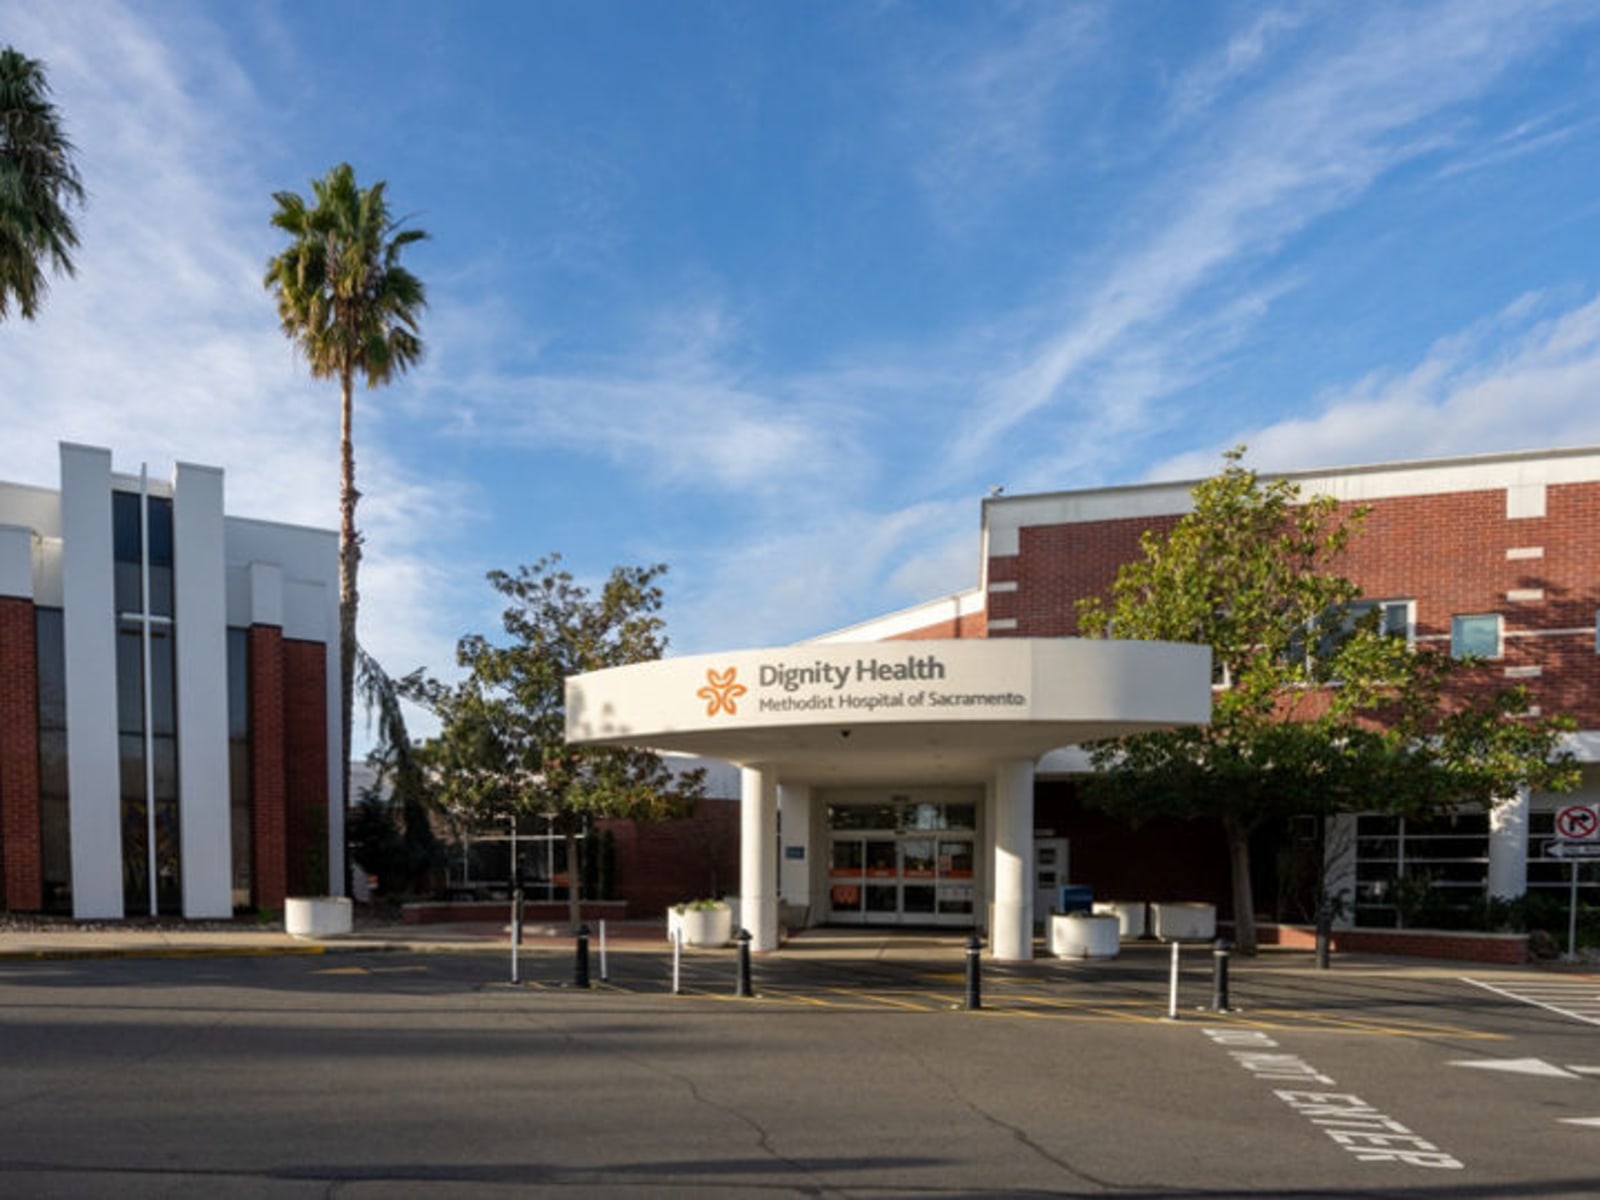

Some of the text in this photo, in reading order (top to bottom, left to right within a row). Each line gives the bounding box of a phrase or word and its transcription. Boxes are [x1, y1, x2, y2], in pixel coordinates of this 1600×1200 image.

[759, 655, 945, 692] Dignity Health
[759, 690, 1026, 712] Methodist Hospital of Sacramento
[1227, 1050, 1336, 1085] NOT
[1273, 1089, 1465, 1169] ENTER
